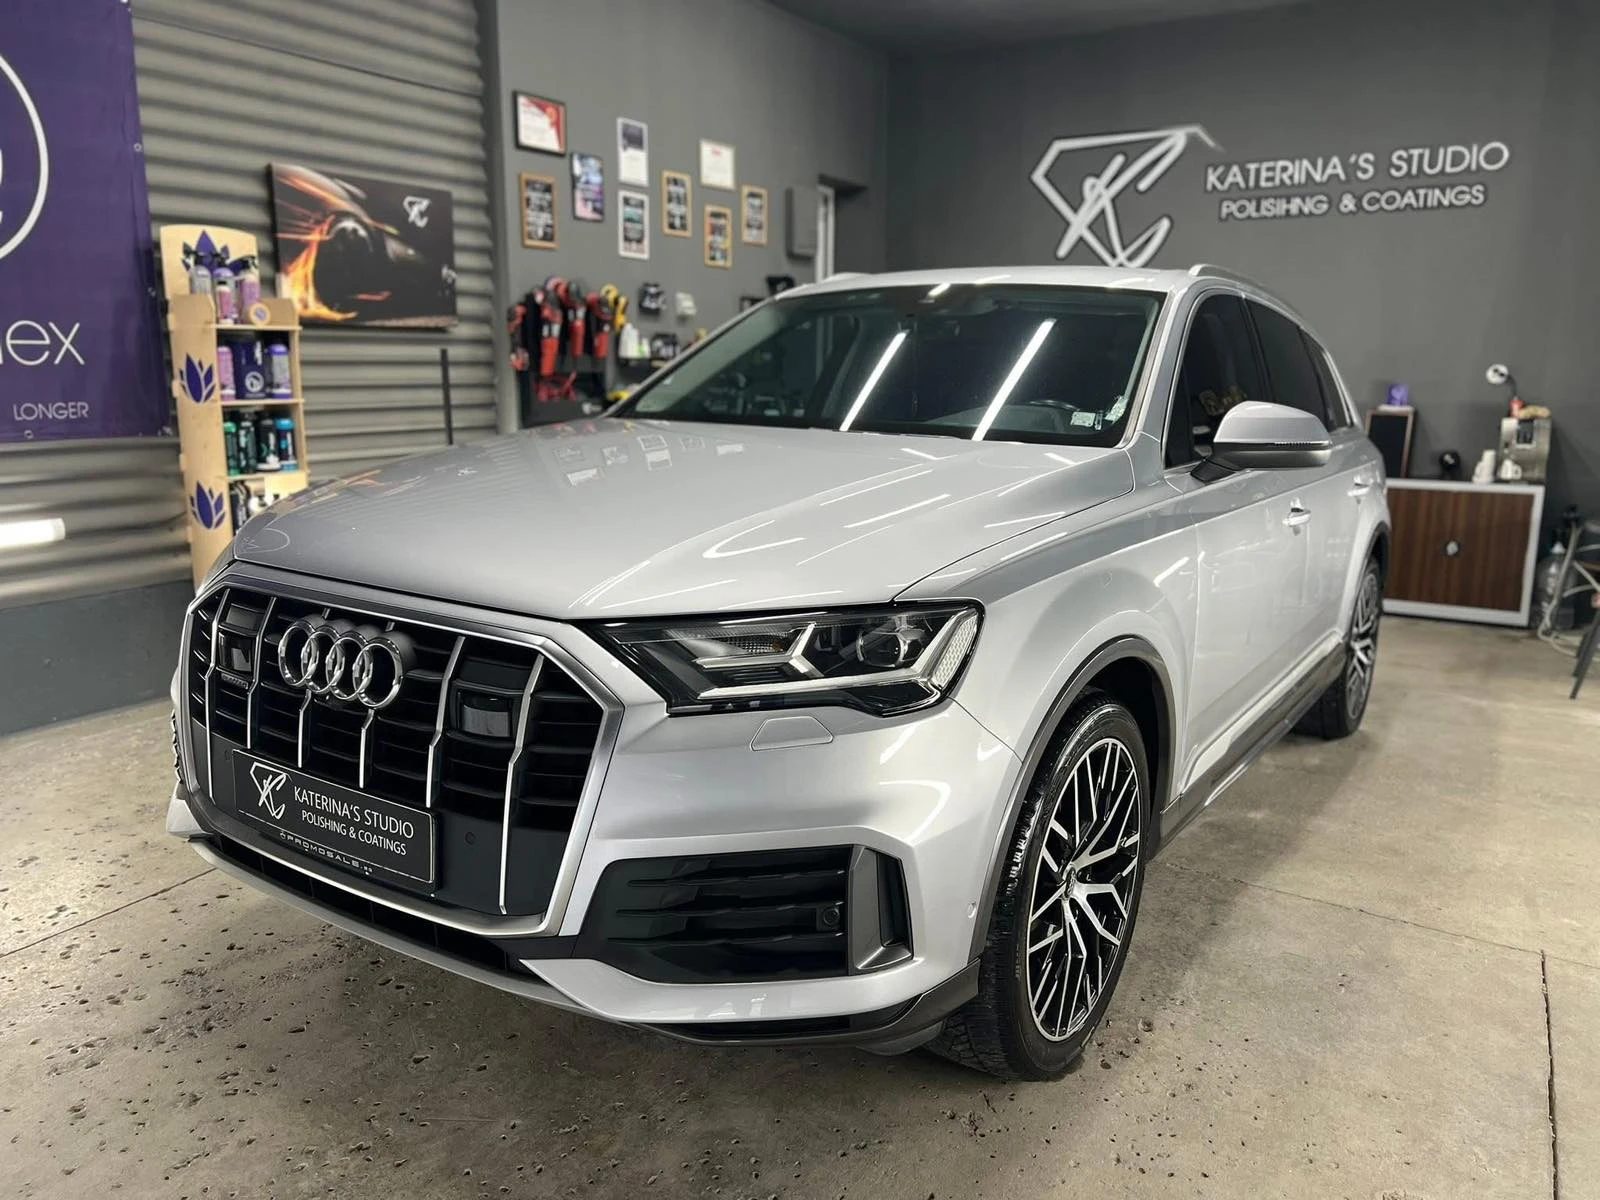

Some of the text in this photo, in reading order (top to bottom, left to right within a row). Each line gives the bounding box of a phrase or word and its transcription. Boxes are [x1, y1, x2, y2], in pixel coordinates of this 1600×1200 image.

[1206, 141, 1509, 191] KATERINA'S STUDIO
[1339, 193, 1357, 213] &
[1362, 184, 1485, 211] COATINGS
[0, 319, 85, 365] ex
[13, 402, 89, 420] LONGER
[294, 785, 414, 839] KATERINA'S STUDIO
[301, 810, 407, 856] POLISHING & COATINGS
